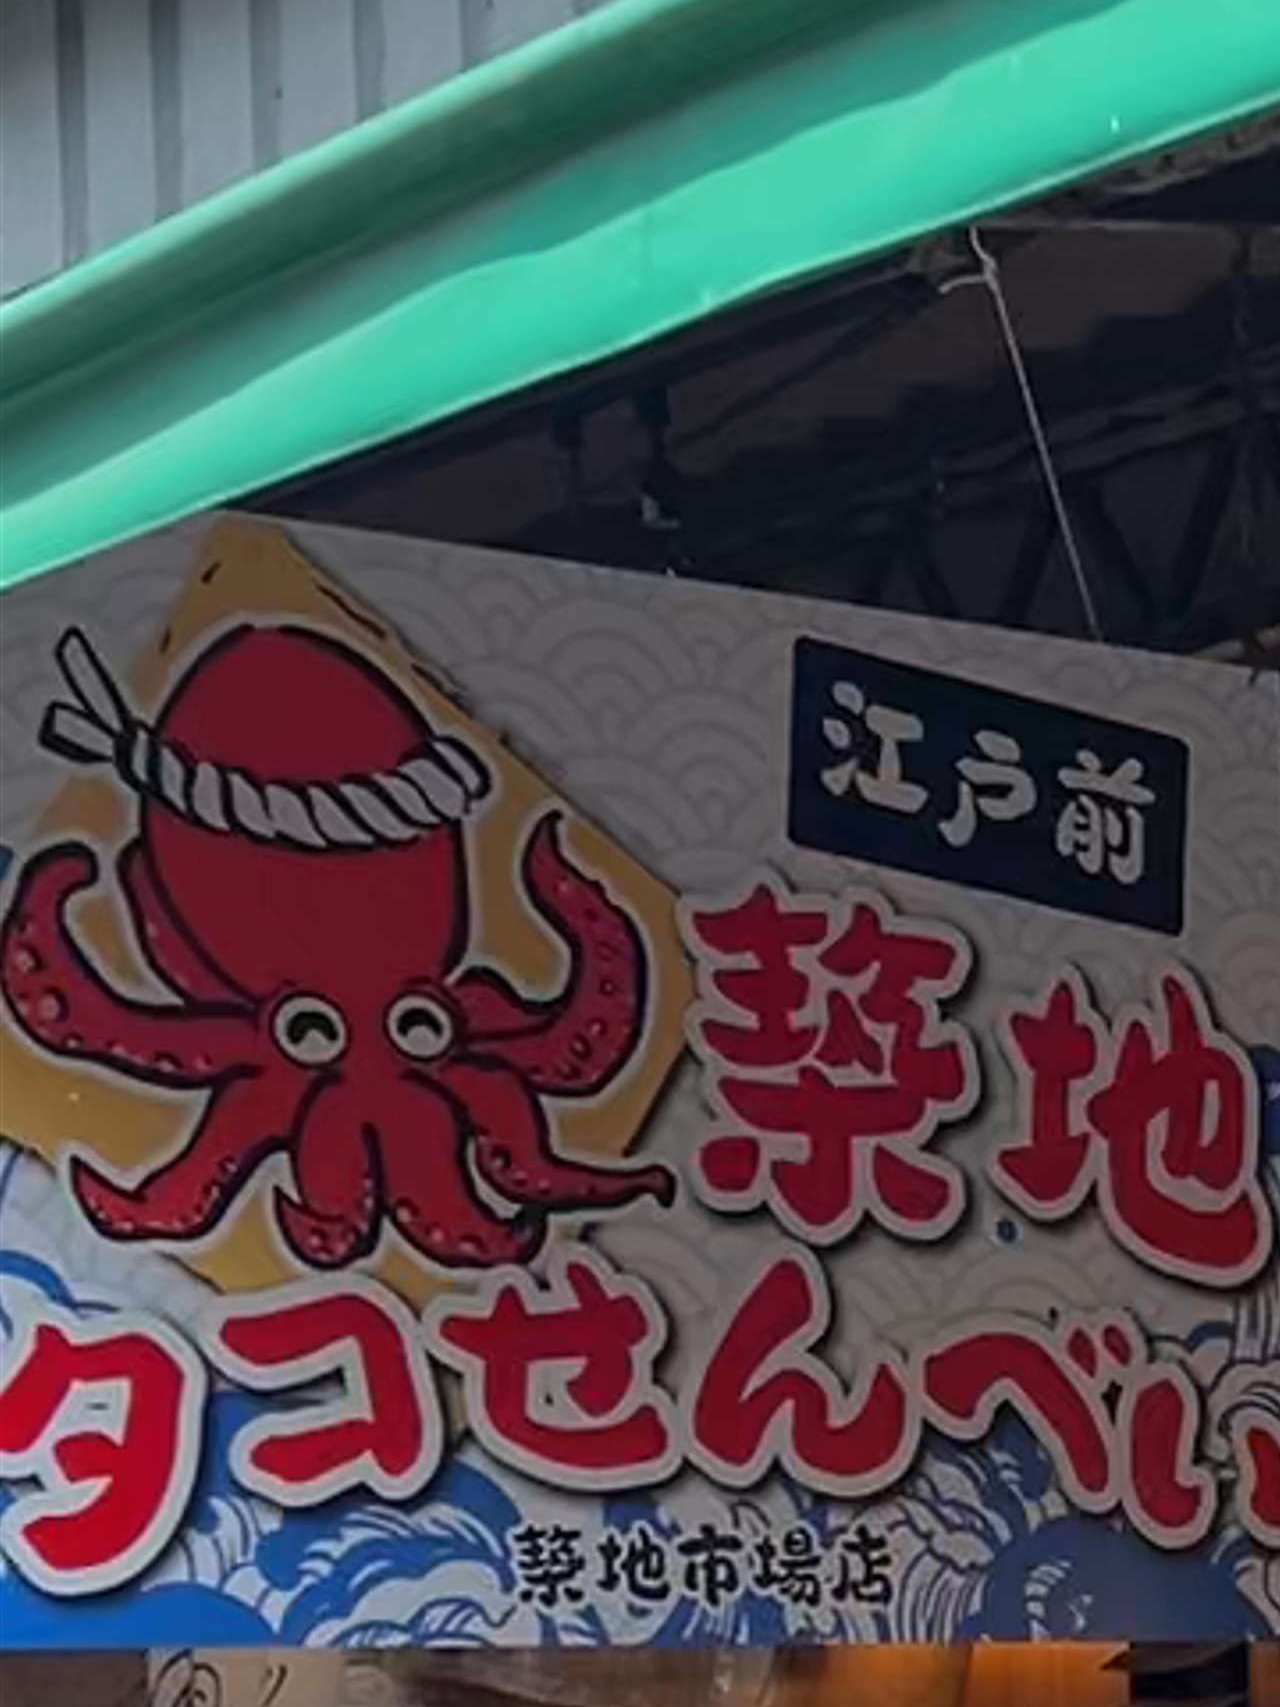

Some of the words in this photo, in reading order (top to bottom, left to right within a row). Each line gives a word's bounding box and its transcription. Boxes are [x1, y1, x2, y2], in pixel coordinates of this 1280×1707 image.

[818, 681, 1157, 887] 江戸前
[692, 881, 1260, 1267] 築地
[512, 1525, 897, 1610] 築地市場店
